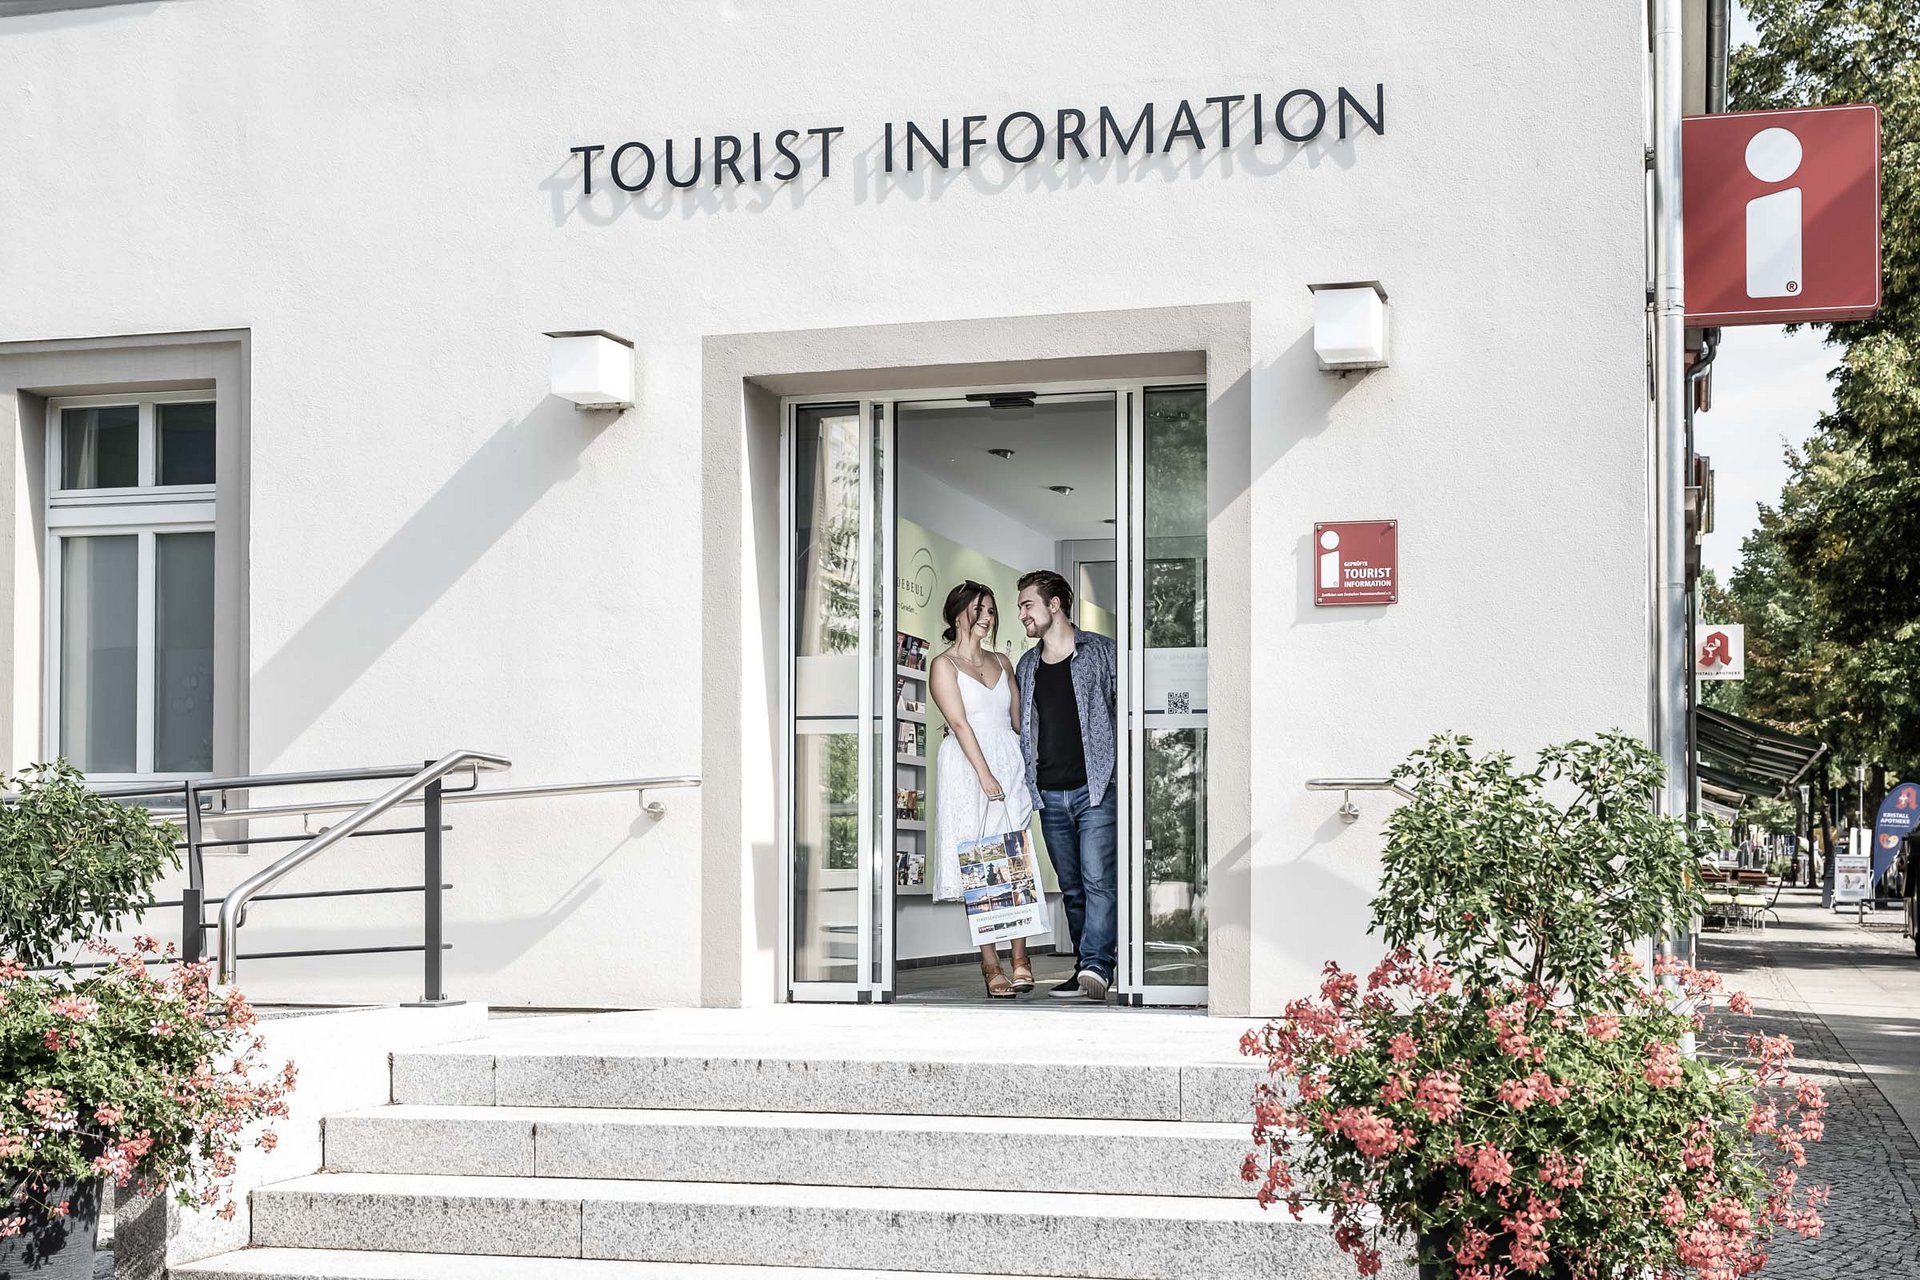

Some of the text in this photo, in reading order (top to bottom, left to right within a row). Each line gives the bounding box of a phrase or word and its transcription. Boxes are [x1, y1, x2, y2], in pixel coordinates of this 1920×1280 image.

[571, 84, 1385, 195] TOURIST INFORMATION
[1343, 567, 1392, 579] TOURIST
[1343, 579, 1392, 588] INFORMATION
